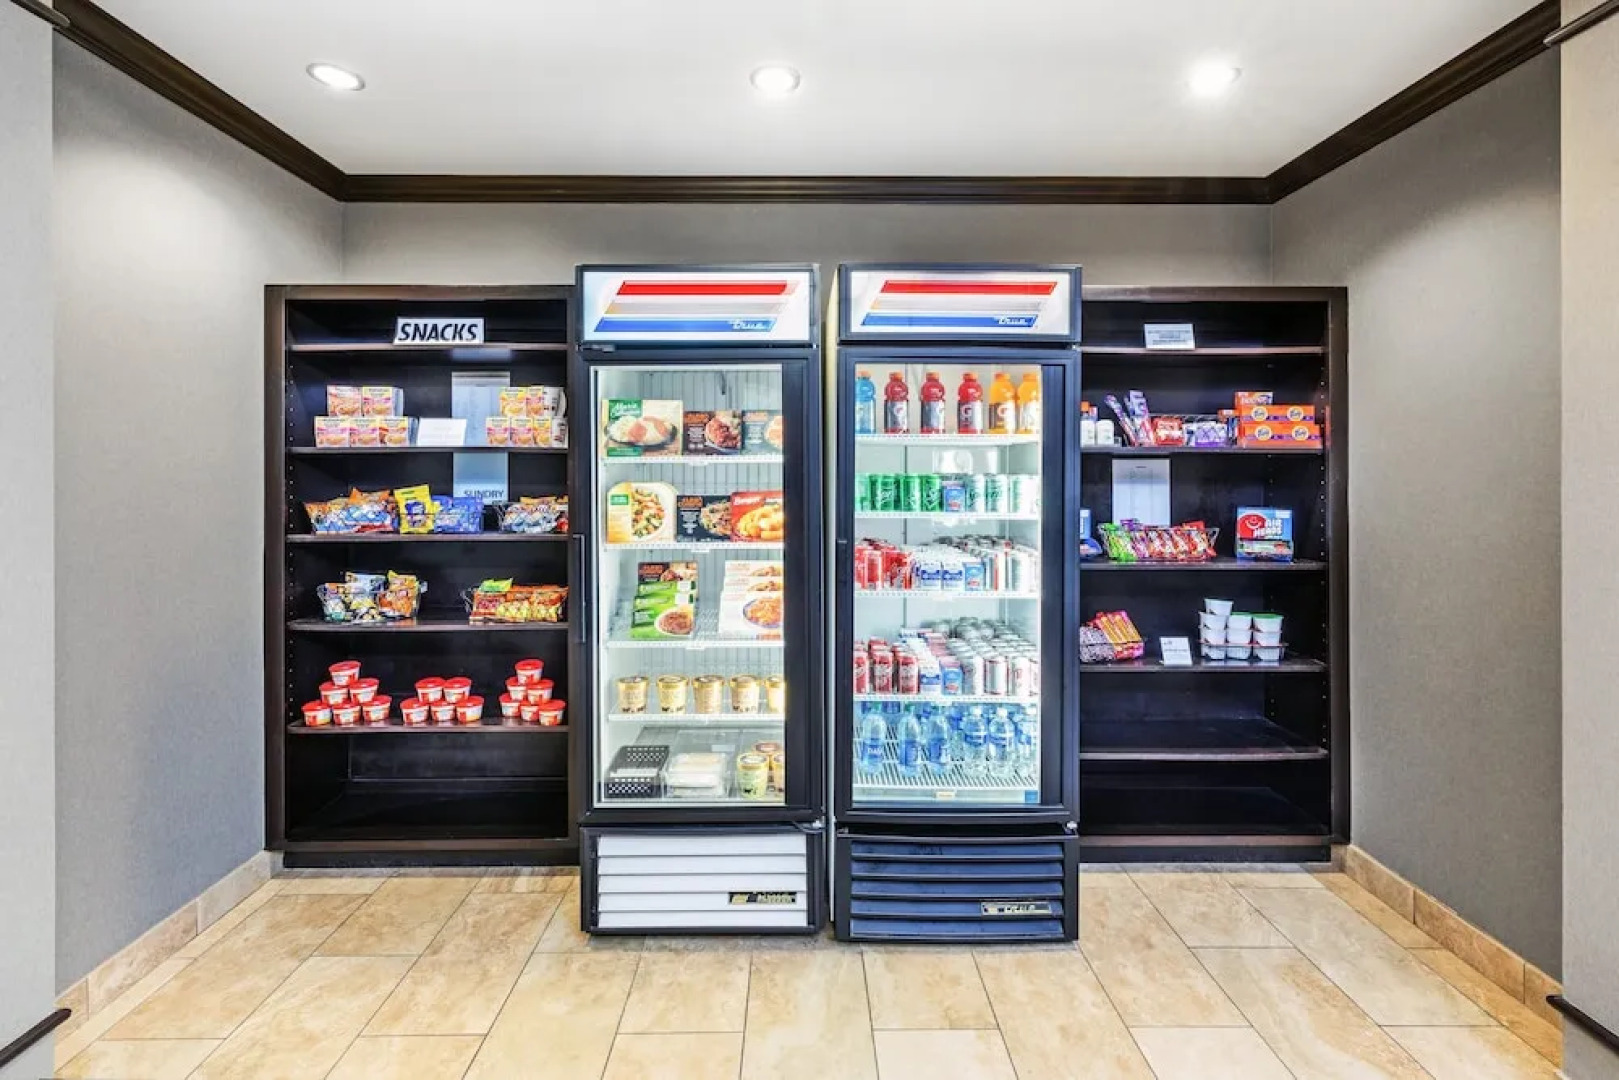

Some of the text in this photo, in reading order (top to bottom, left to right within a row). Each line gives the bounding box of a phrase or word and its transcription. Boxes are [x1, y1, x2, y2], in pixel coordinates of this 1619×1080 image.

[398, 323, 478, 341] SNACKS
[961, 405, 972, 416] G
[464, 490, 504, 498] SUNDRY
